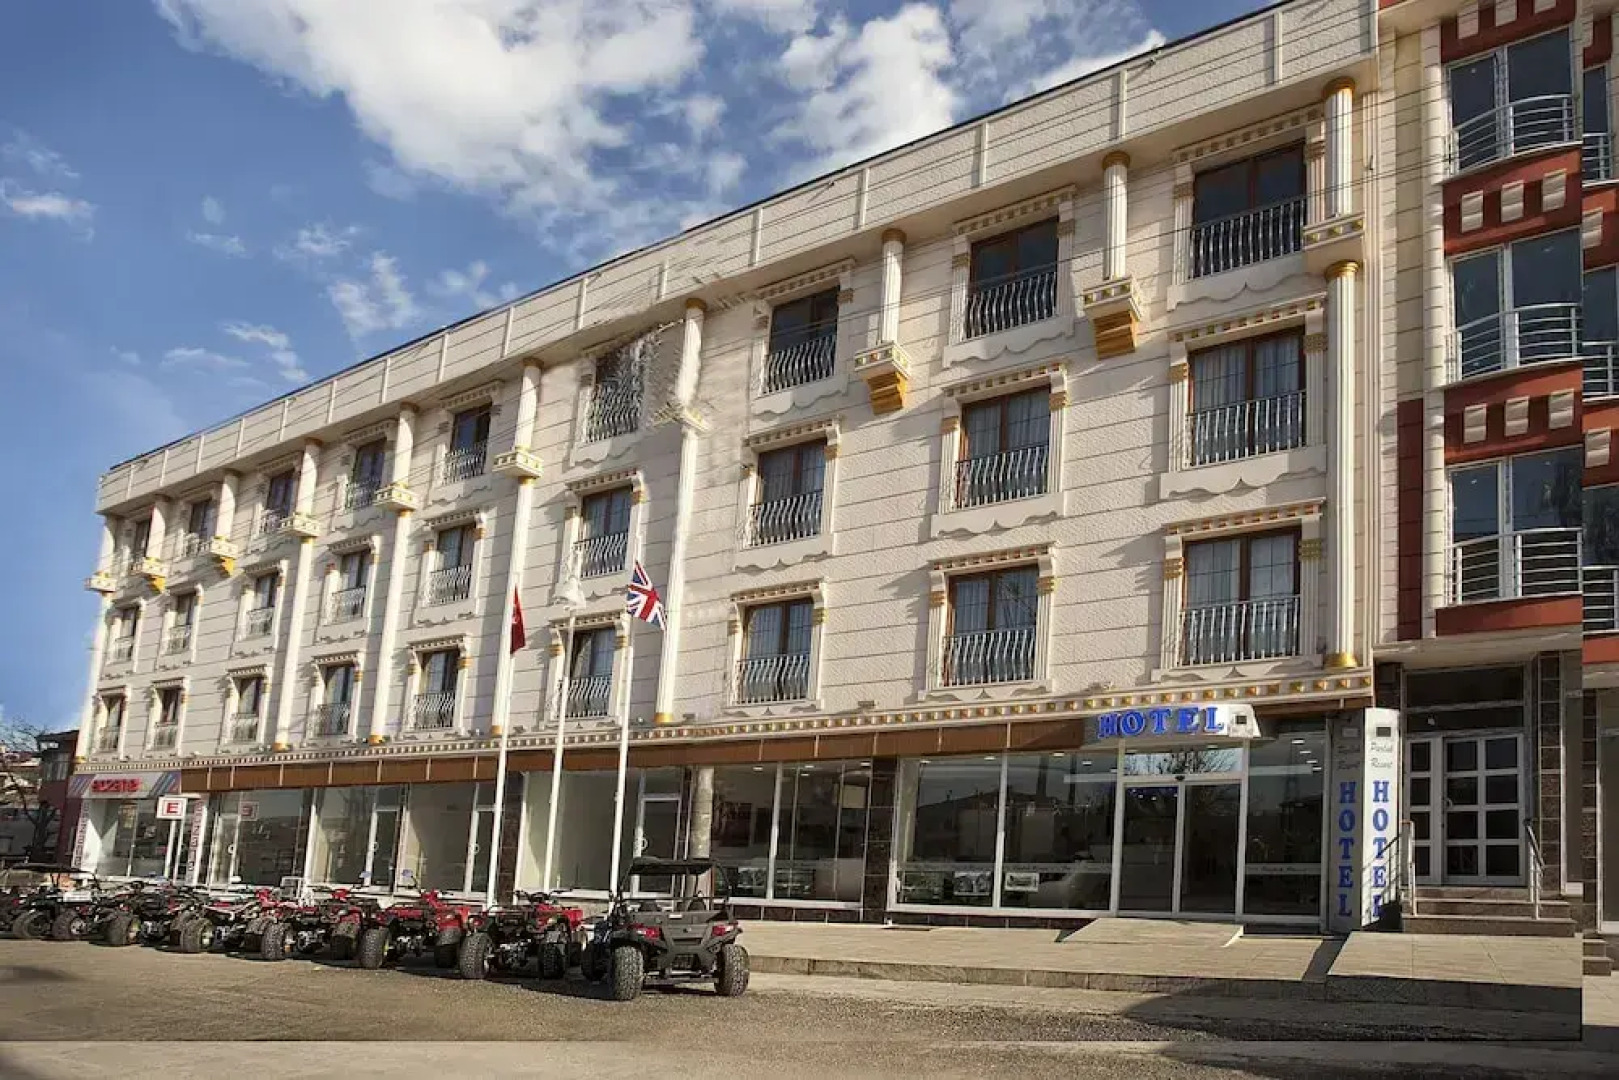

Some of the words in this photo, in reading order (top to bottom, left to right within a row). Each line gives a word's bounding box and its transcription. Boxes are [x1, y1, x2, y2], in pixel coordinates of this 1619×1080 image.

[1097, 706, 1225, 740] HOTEL
[166, 802, 179, 814] E
[1338, 781, 1357, 917] HOTEL
[1372, 780, 1390, 917] HOTEL
